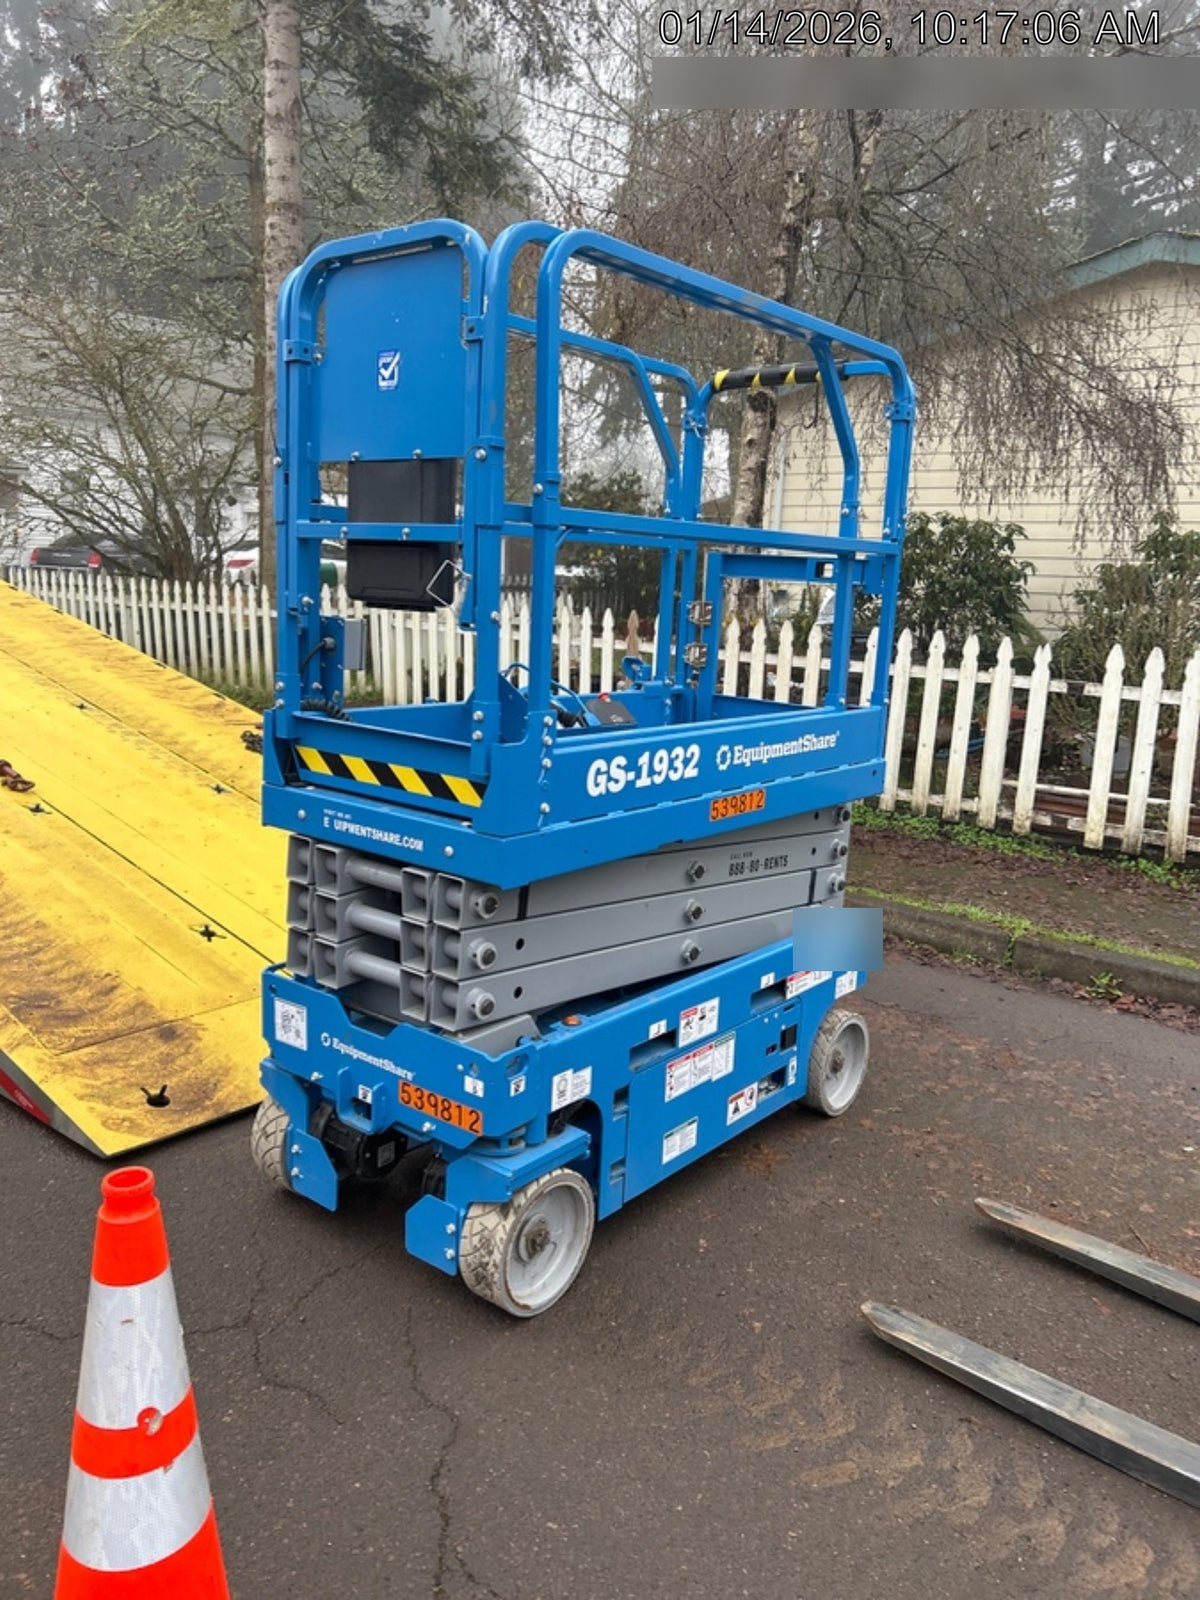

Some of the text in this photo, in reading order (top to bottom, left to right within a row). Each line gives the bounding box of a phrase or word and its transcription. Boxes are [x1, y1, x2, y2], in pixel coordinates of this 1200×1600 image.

[732, 733, 837, 767] EquipmentShare
[586, 743, 700, 797] GS-1932
[711, 789, 765, 820] 539812
[323, 816, 424, 852] EUIPMENTSHARE.COM
[400, 1082, 481, 1133] 539812
